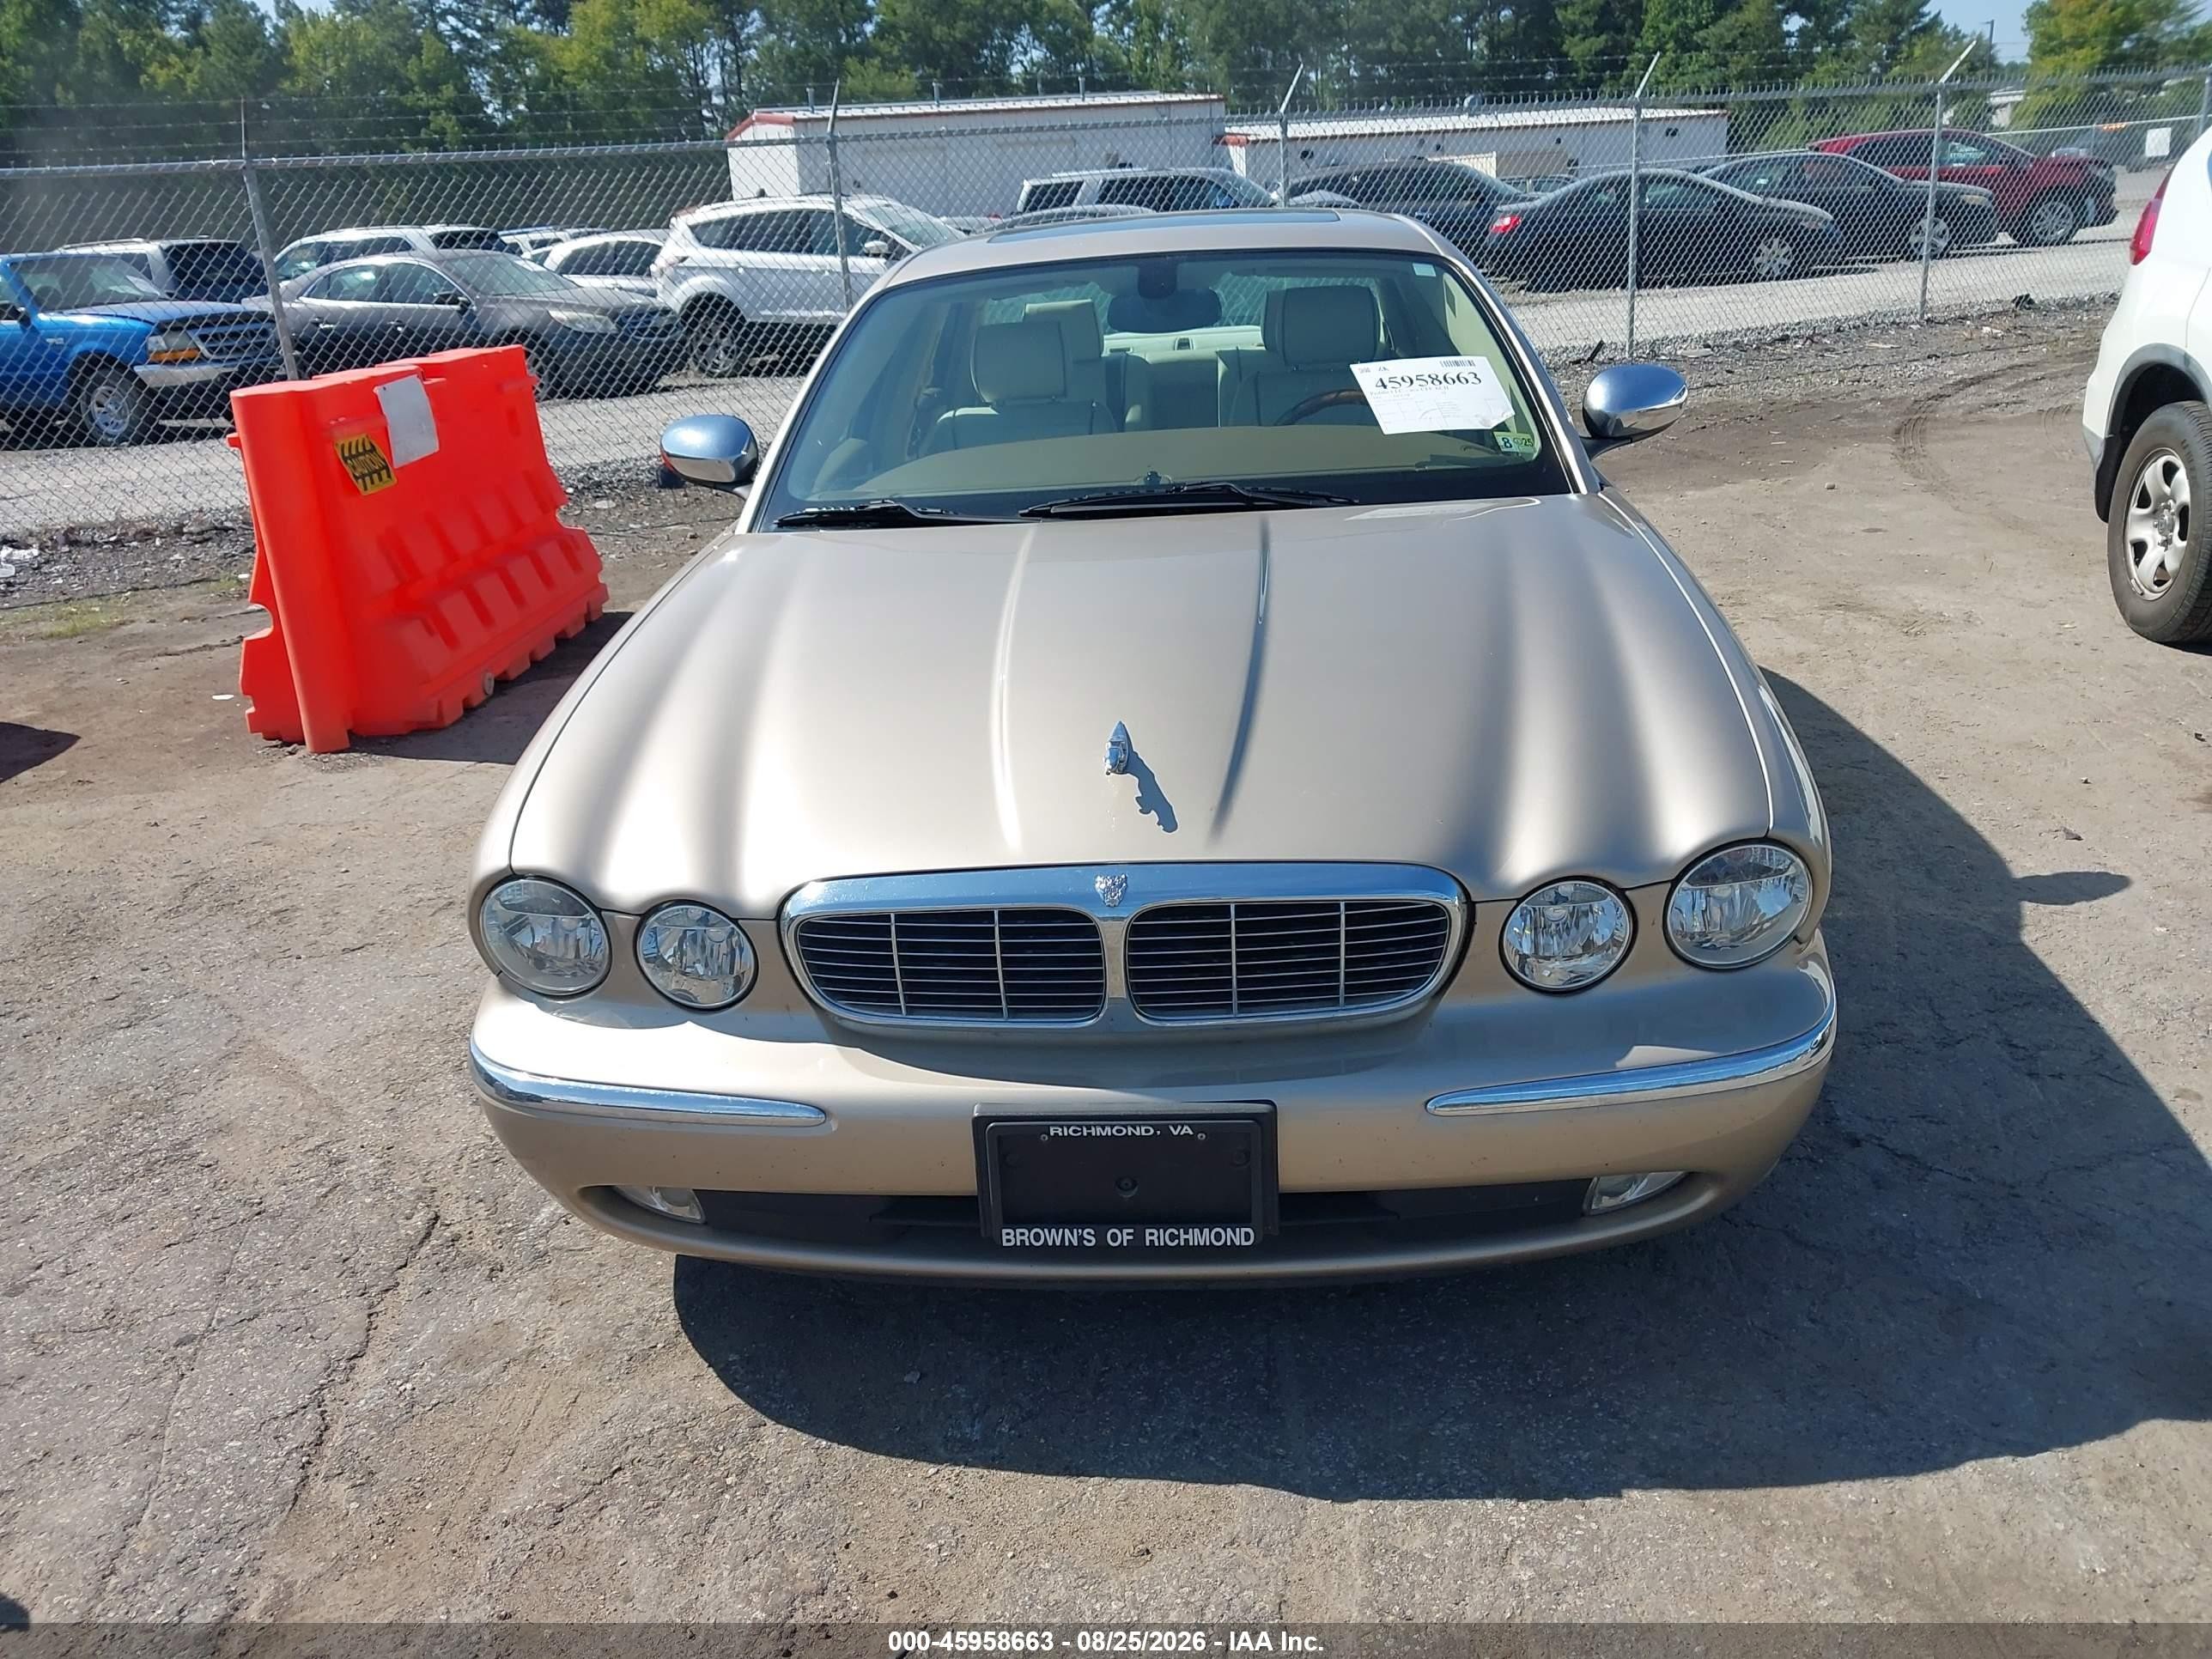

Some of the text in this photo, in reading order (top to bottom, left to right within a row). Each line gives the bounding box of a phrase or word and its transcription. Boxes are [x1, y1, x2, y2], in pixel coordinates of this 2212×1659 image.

[1375, 371, 1482, 390] 45958663
[1502, 437, 1513, 448] 8
[1169, 1125, 1194, 1136] VA
[1001, 1227, 1255, 1246] BROWN'S OF RICHMOND
